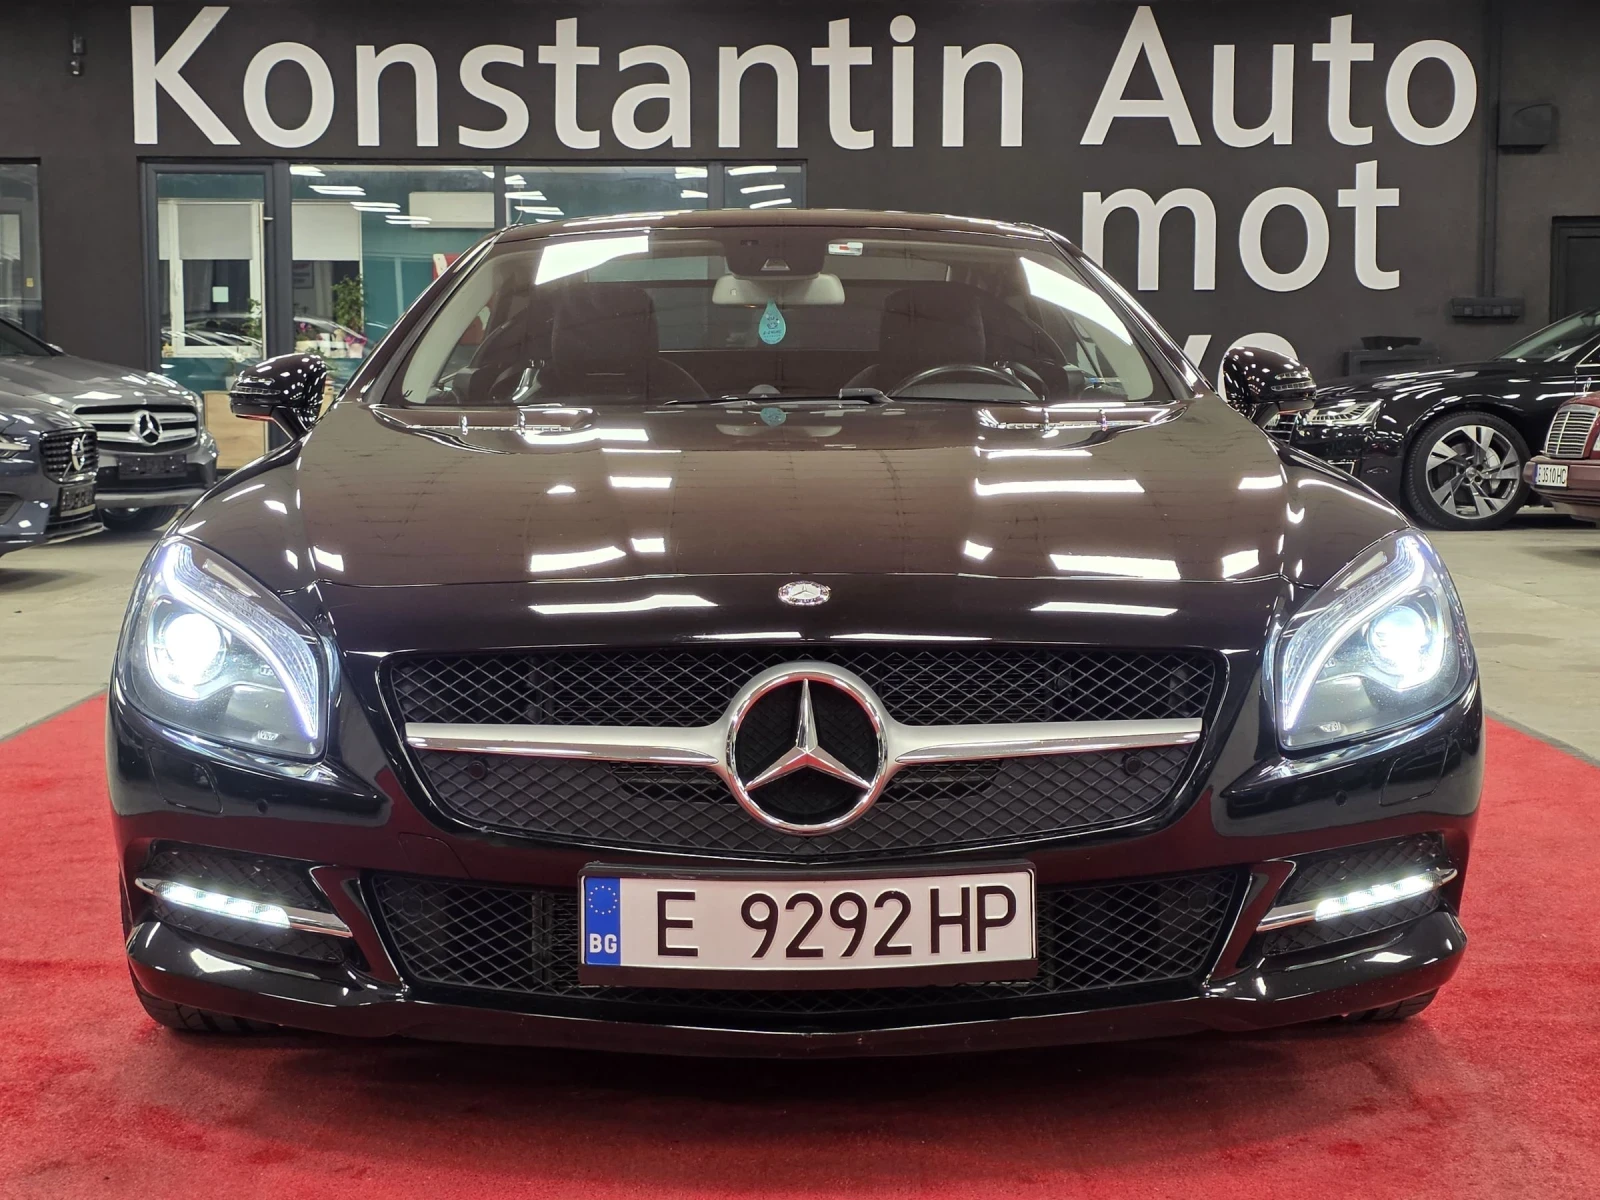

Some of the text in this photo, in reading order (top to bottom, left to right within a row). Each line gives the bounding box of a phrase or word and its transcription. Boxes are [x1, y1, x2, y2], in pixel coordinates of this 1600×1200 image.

[131, 6, 1477, 149] Konstantin Auto
[1082, 160, 1400, 292] mot
[589, 934, 618, 954] BG
[658, 886, 1017, 959] E 9292 HP
